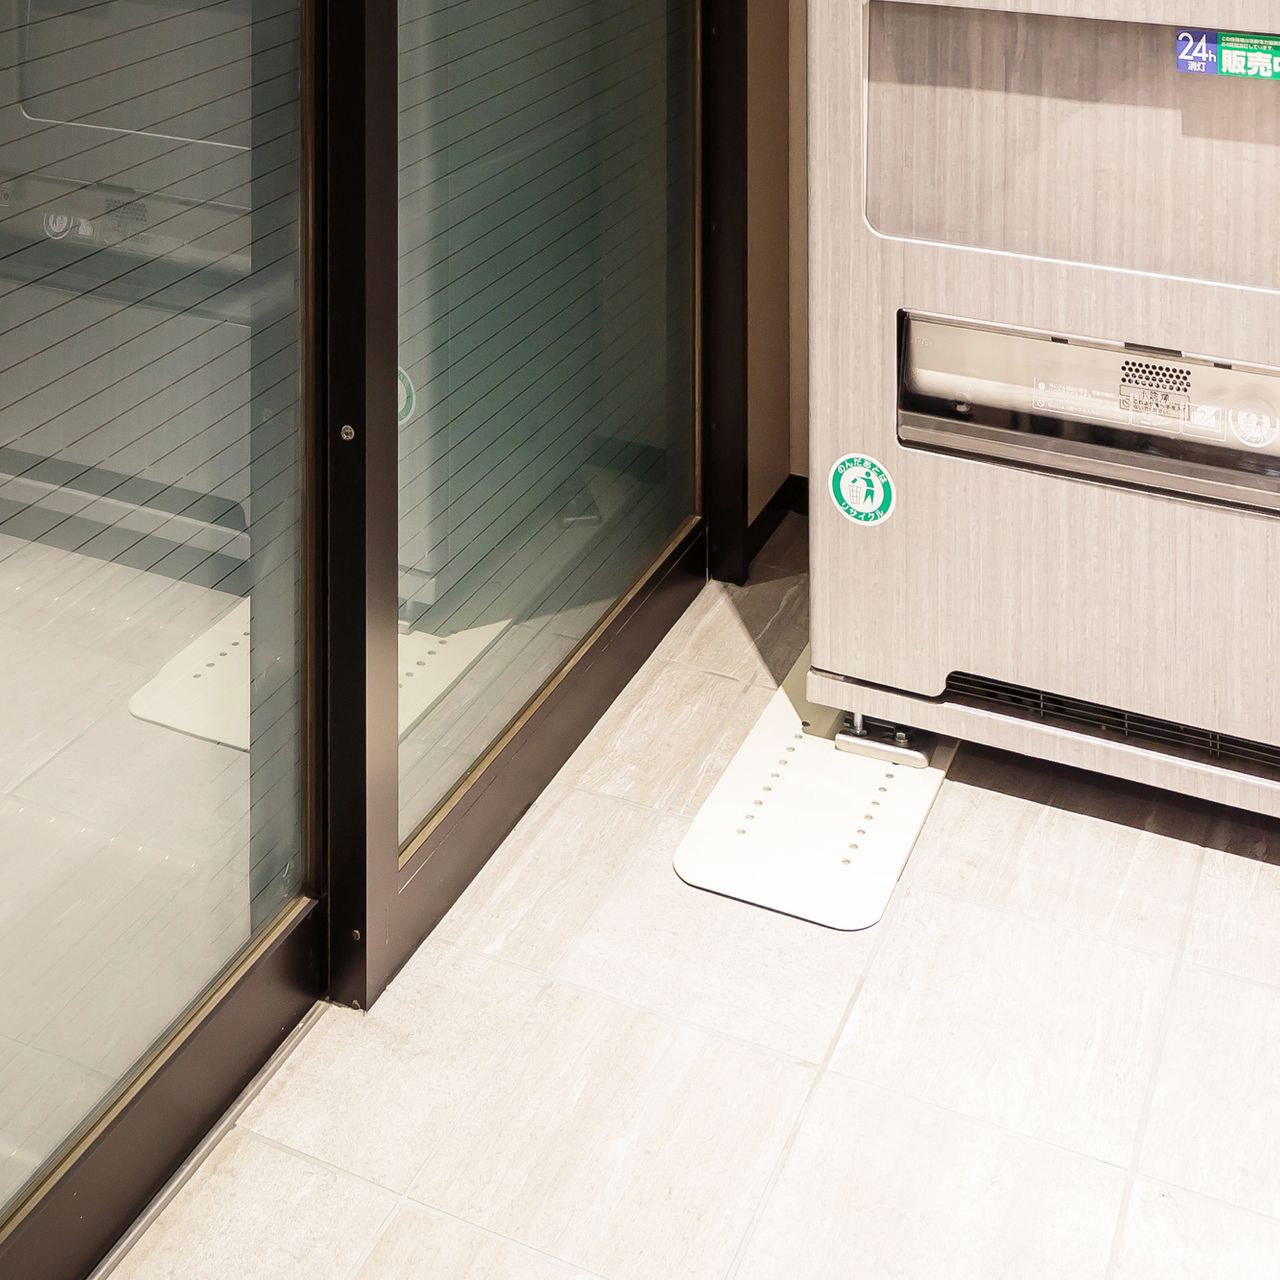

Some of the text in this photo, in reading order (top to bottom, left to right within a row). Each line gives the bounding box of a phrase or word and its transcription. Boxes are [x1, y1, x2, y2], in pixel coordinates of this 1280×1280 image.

[1178, 32, 1217, 63] 24h
[837, 457, 888, 484] のんだあとは
[841, 502, 884, 521] リサイクル
